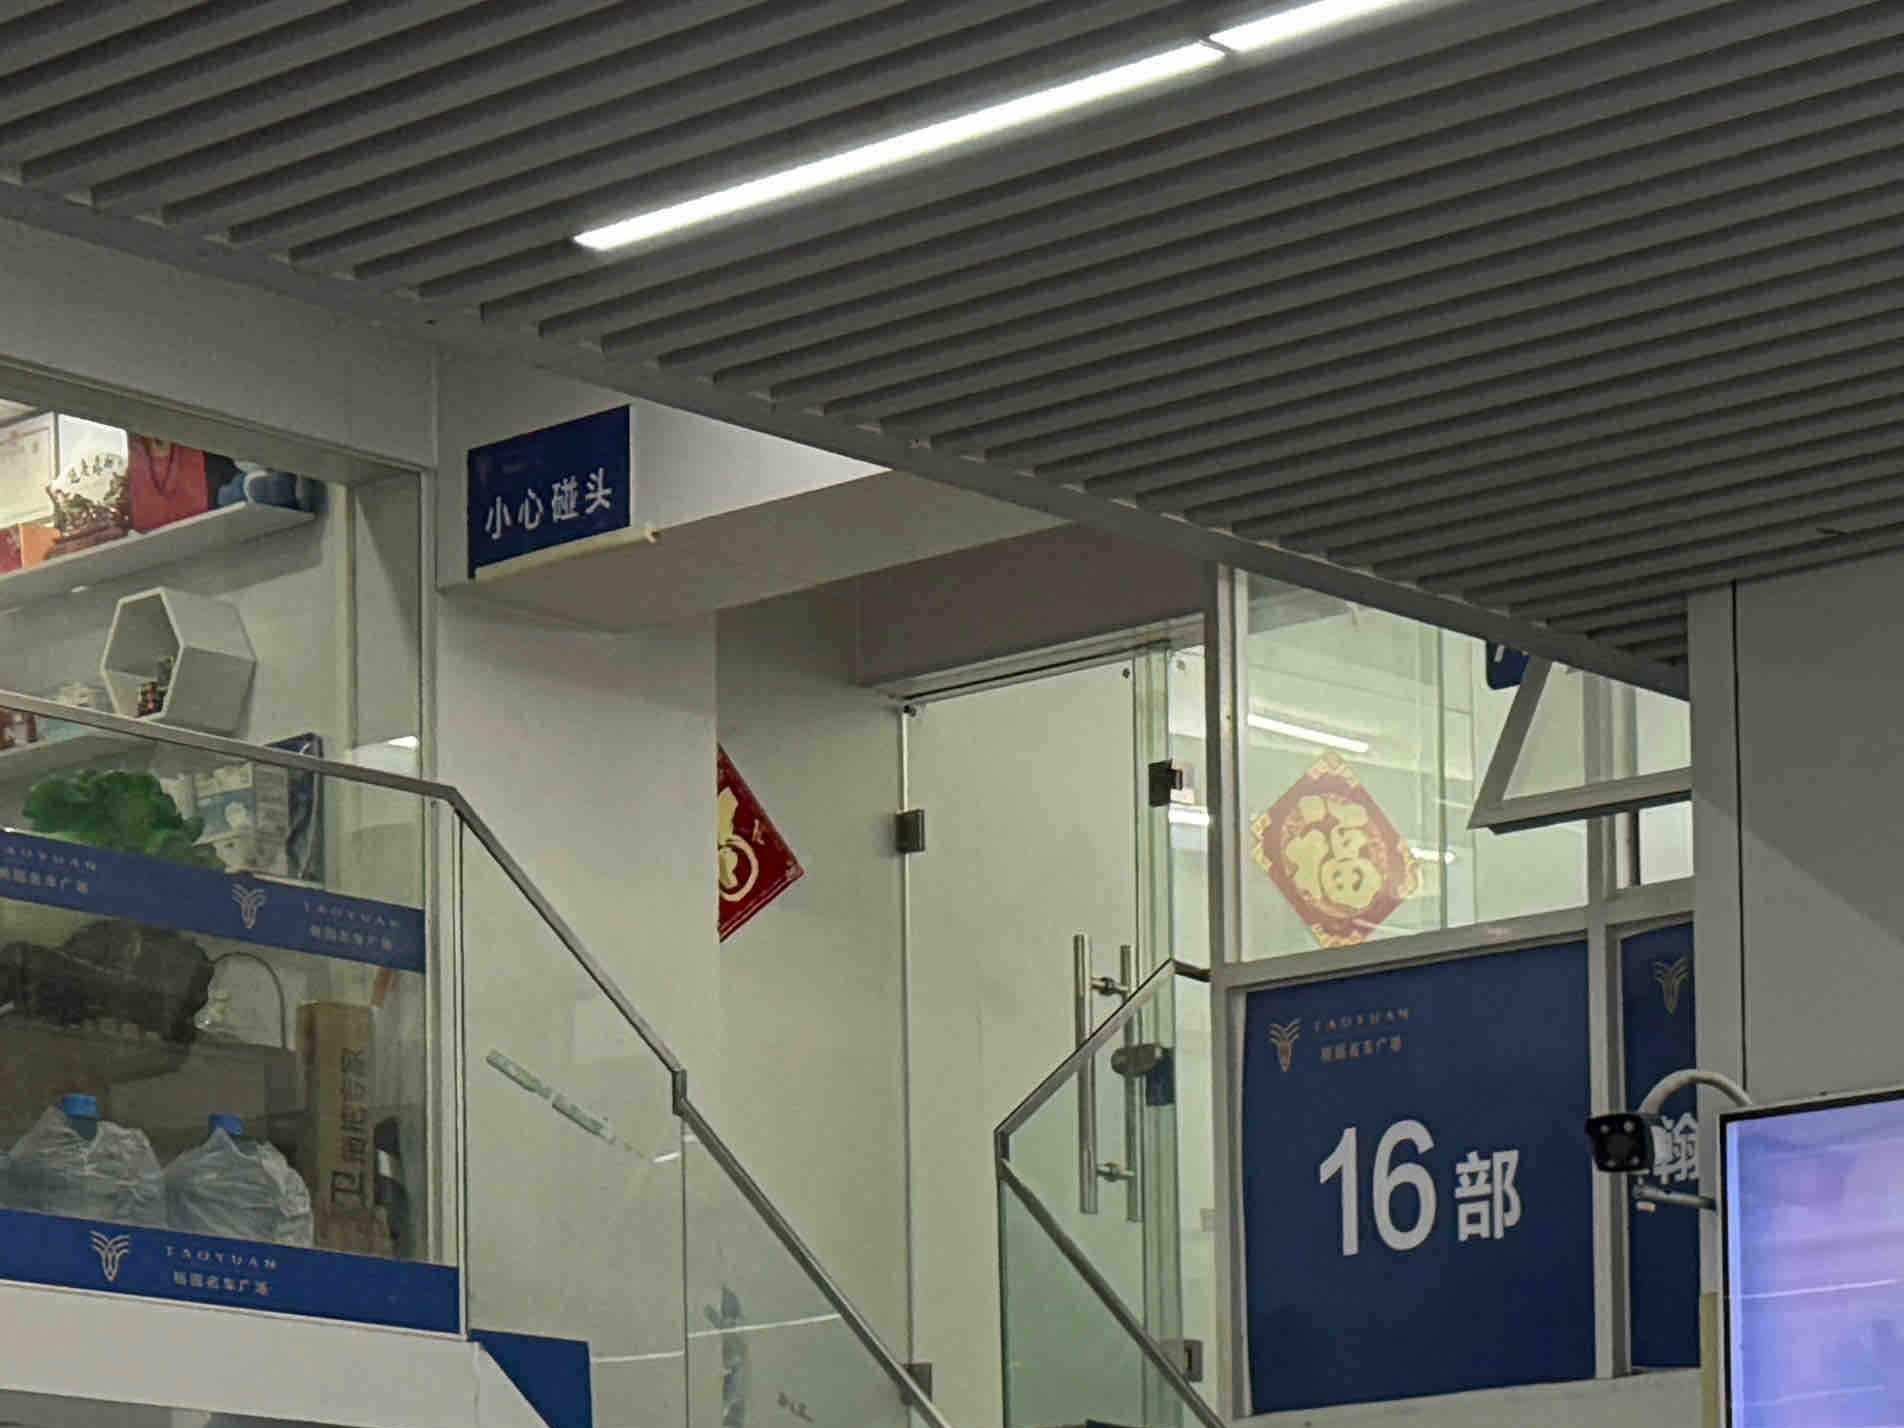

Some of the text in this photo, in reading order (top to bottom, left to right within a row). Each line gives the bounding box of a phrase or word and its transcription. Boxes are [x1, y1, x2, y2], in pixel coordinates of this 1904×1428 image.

[485, 467, 612, 540] 小心碰头
[1320, 1119, 1521, 1257] 16部
[166, 1246, 277, 1271] TAOYUAN
